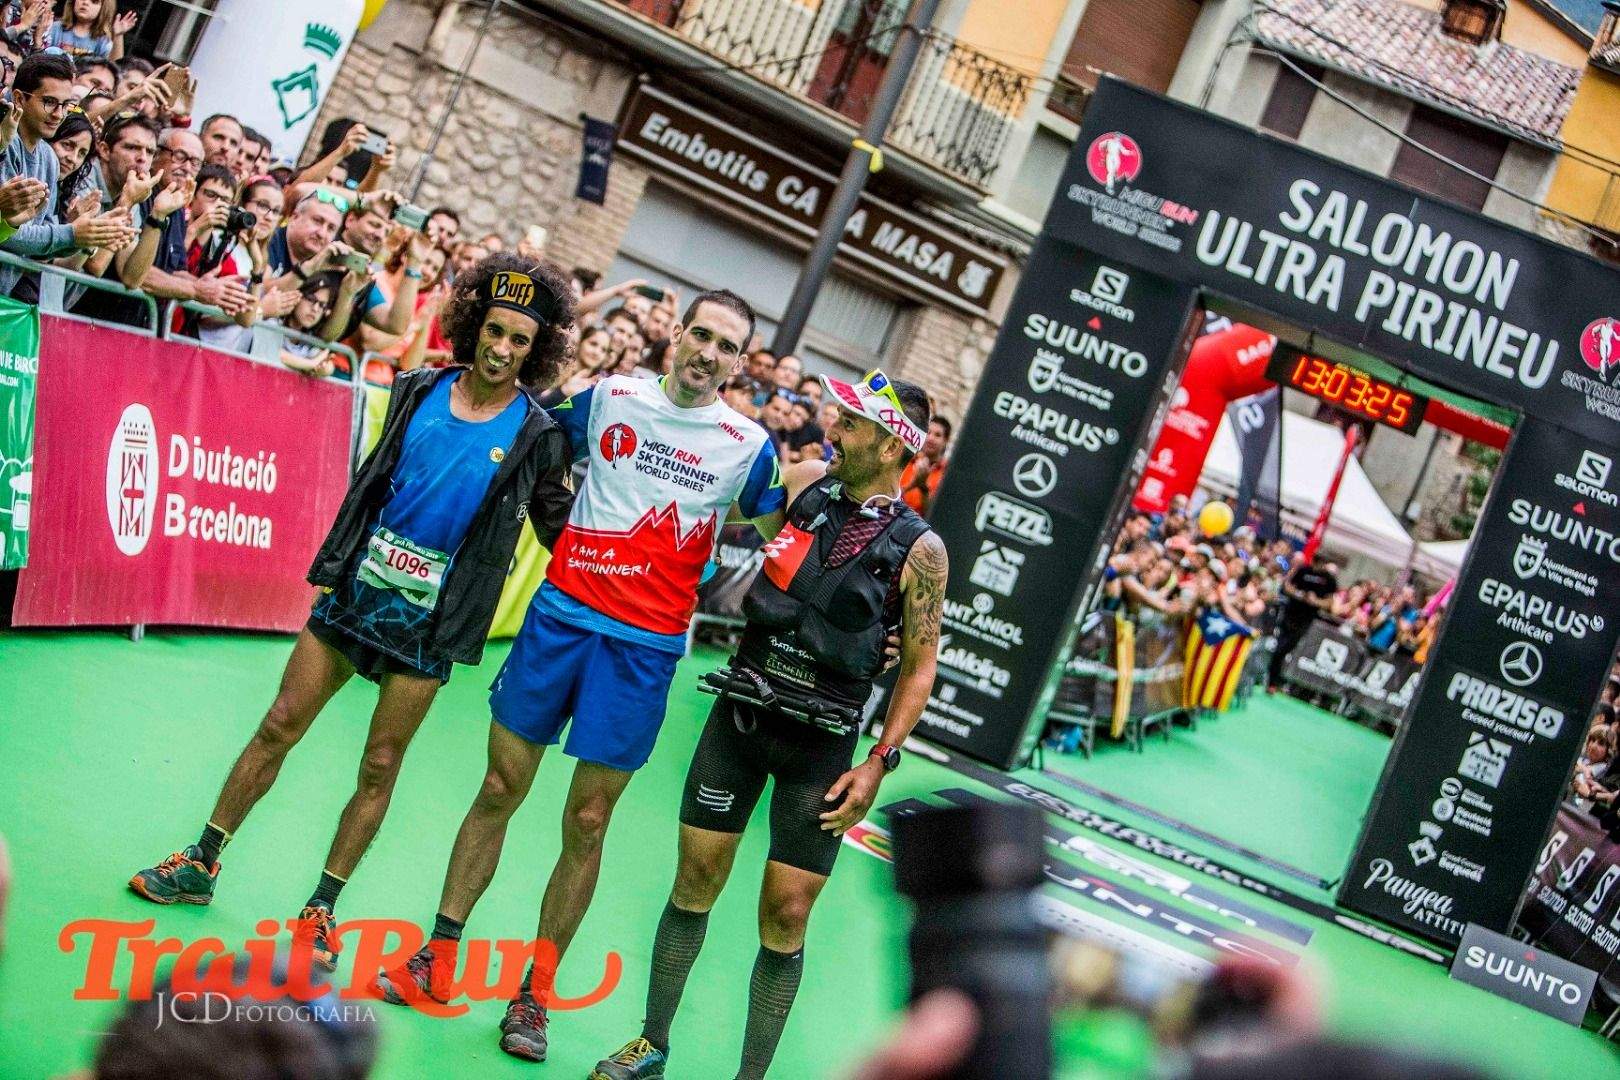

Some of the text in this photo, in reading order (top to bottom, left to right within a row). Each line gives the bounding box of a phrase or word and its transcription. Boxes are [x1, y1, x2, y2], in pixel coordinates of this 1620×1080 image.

[639, 112, 954, 281] Embotits CA A MASA
[1278, 178, 1519, 310] SALOMON
[1196, 209, 1560, 389] ULTRA PIRINEU
[1023, 313, 1148, 377] SUUNTO
[1291, 356, 1413, 424] 13:03:25
[994, 391, 1102, 452] EPAPLUS
[635, 462, 705, 493] WORLD SERIES
[1553, 472, 1618, 508] salomon
[384, 548, 432, 578] 1096
[1478, 578, 1590, 640] EPAPLUS
[1497, 611, 1554, 645] Arthicare
[1447, 671, 1540, 730] PROZIS
[1363, 858, 1453, 915] Pangea
[1465, 946, 1582, 1005] SUUNTO
